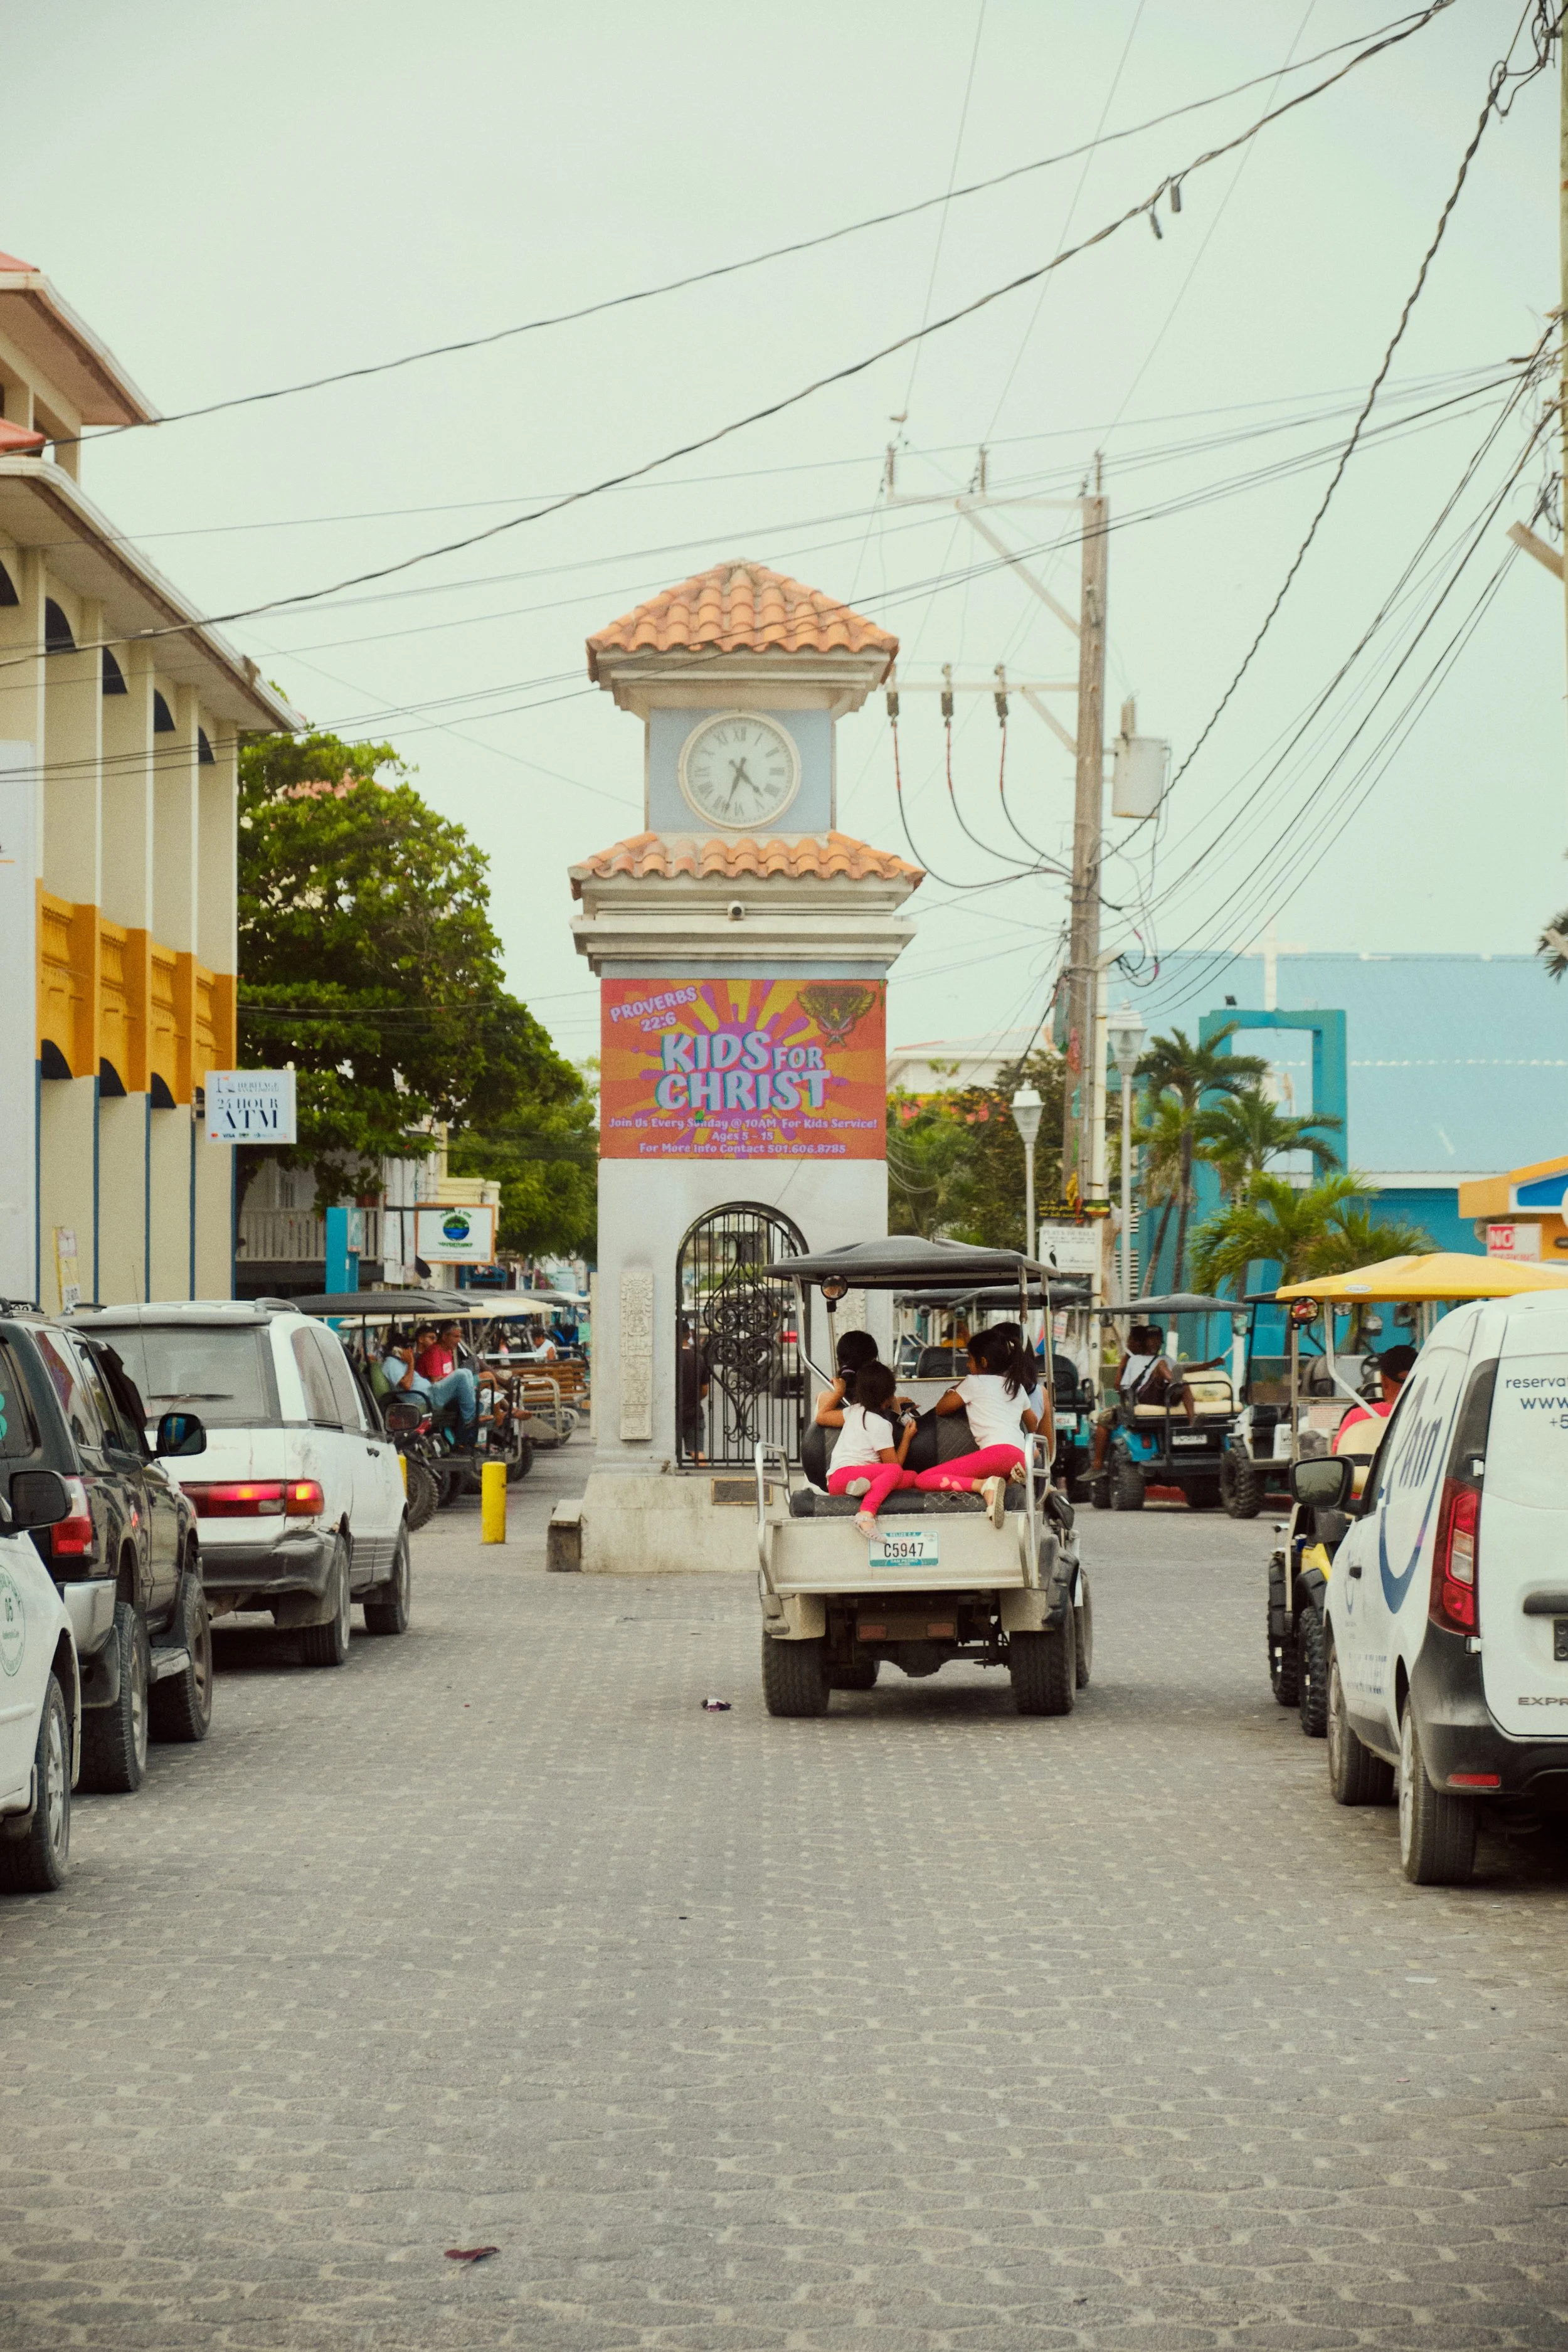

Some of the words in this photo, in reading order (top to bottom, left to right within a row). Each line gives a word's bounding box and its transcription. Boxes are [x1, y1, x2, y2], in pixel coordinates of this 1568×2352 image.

[610, 985, 697, 1023] PROVERBS
[640, 1011, 677, 1032] 22:6
[660, 1030, 772, 1073] KIDS
[772, 1046, 825, 1070] FOR
[655, 1069, 832, 1111] CHRIST
[237, 1098, 278, 1109] HOUR
[221, 1110, 277, 1129] ATM
[608, 1118, 632, 1128] Join
[635, 1118, 649, 1128] Us
[651, 1119, 684, 1130] Every
[730, 1118, 742, 1128] @
[745, 1118, 776, 1128] 10AM
[781, 1118, 802, 1128] For
[803, 1118, 829, 1129] Kids
[830, 1118, 878, 1129] Service!
[711, 1131, 739, 1142] Ages
[741, 1131, 749, 1141] 5
[761, 1131, 774, 1141] 15
[639, 1143, 659, 1153] For
[662, 1143, 691, 1153] More
[719, 1144, 765, 1153] Contact
[767, 1144, 846, 1154] 501.606.8785
[1488, 1229, 1515, 1248] NO
[1506, 1377, 1568, 1388] reserva
[884, 1542, 924, 1557] C5947
